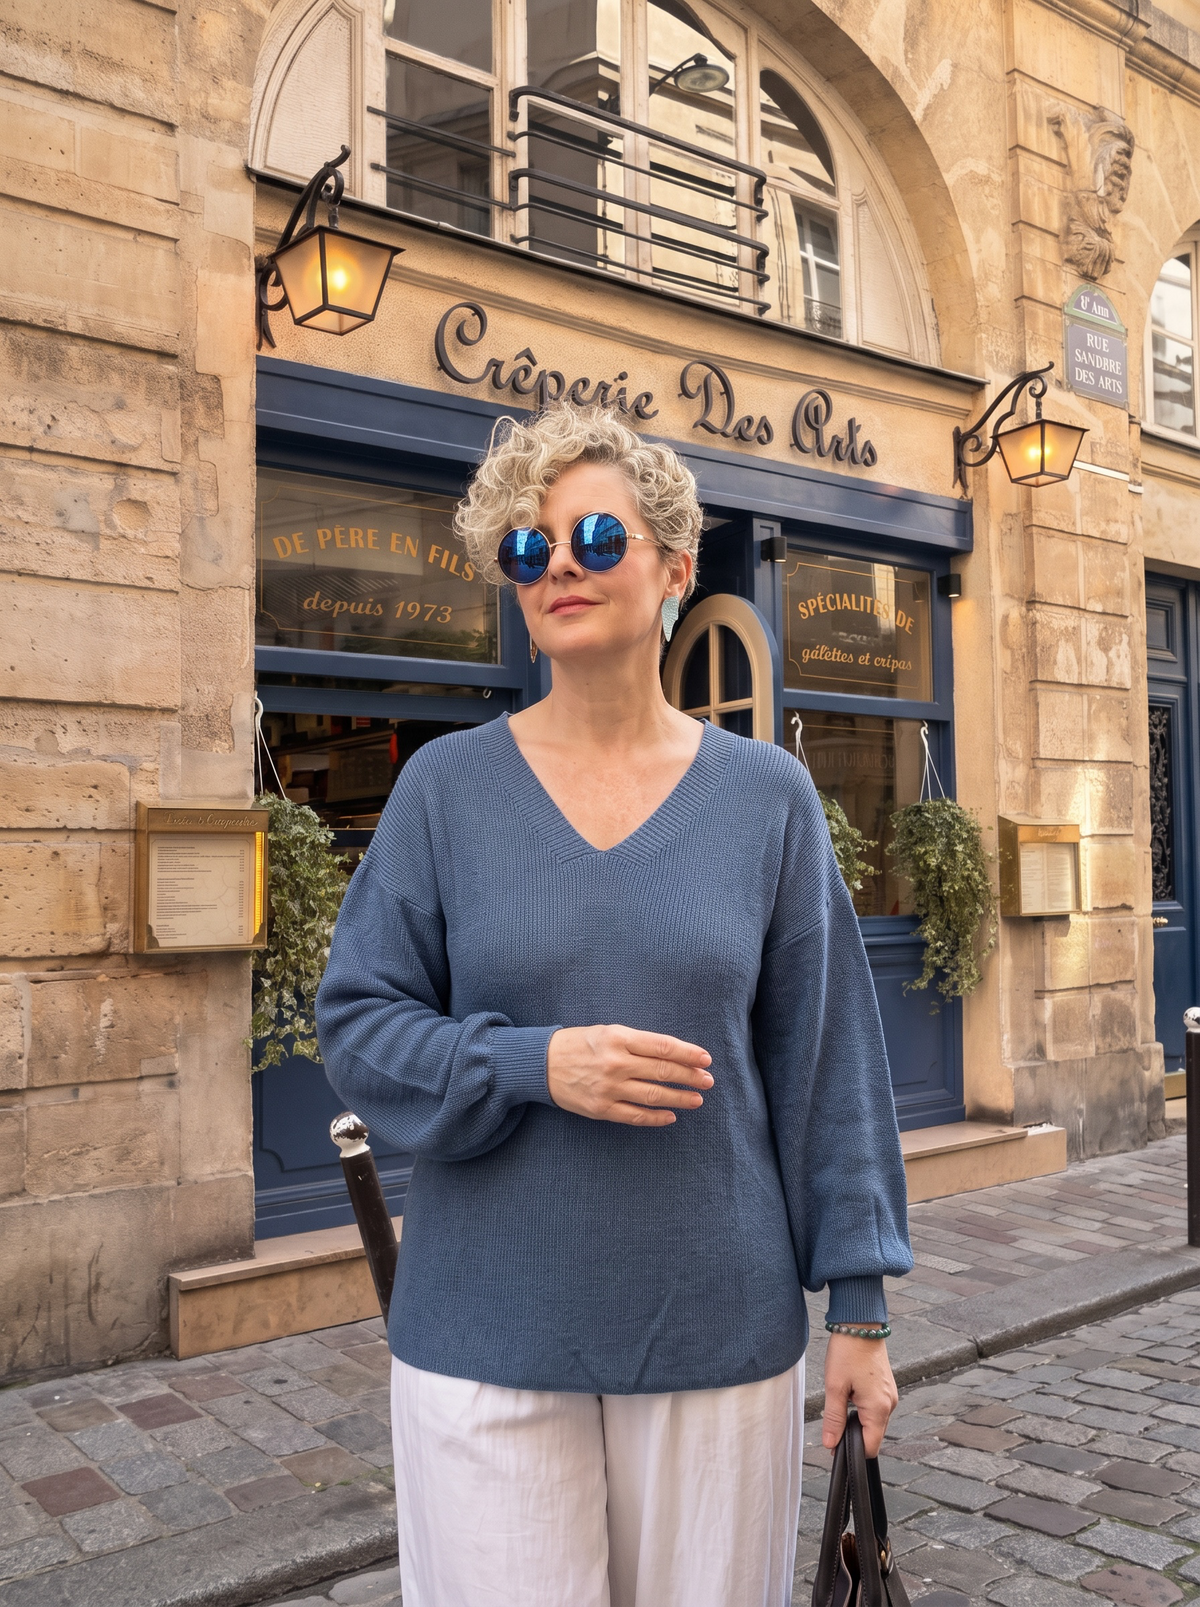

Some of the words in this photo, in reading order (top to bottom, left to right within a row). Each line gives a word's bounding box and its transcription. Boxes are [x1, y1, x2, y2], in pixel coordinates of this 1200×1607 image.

[1086, 332, 1109, 353] RUE
[434, 301, 659, 421] Crêperie
[677, 359, 774, 445] Des
[789, 388, 878, 468] Arts
[1075, 367, 1095, 386] DES
[1098, 375, 1123, 394] ARTS
[272, 532, 309, 559] DE
[390, 532, 419, 558] EN
[427, 544, 477, 582] FILS
[303, 591, 384, 618] depuis
[395, 600, 453, 624] 1973
[896, 609, 915, 635] DE
[858, 652, 871, 666] et
